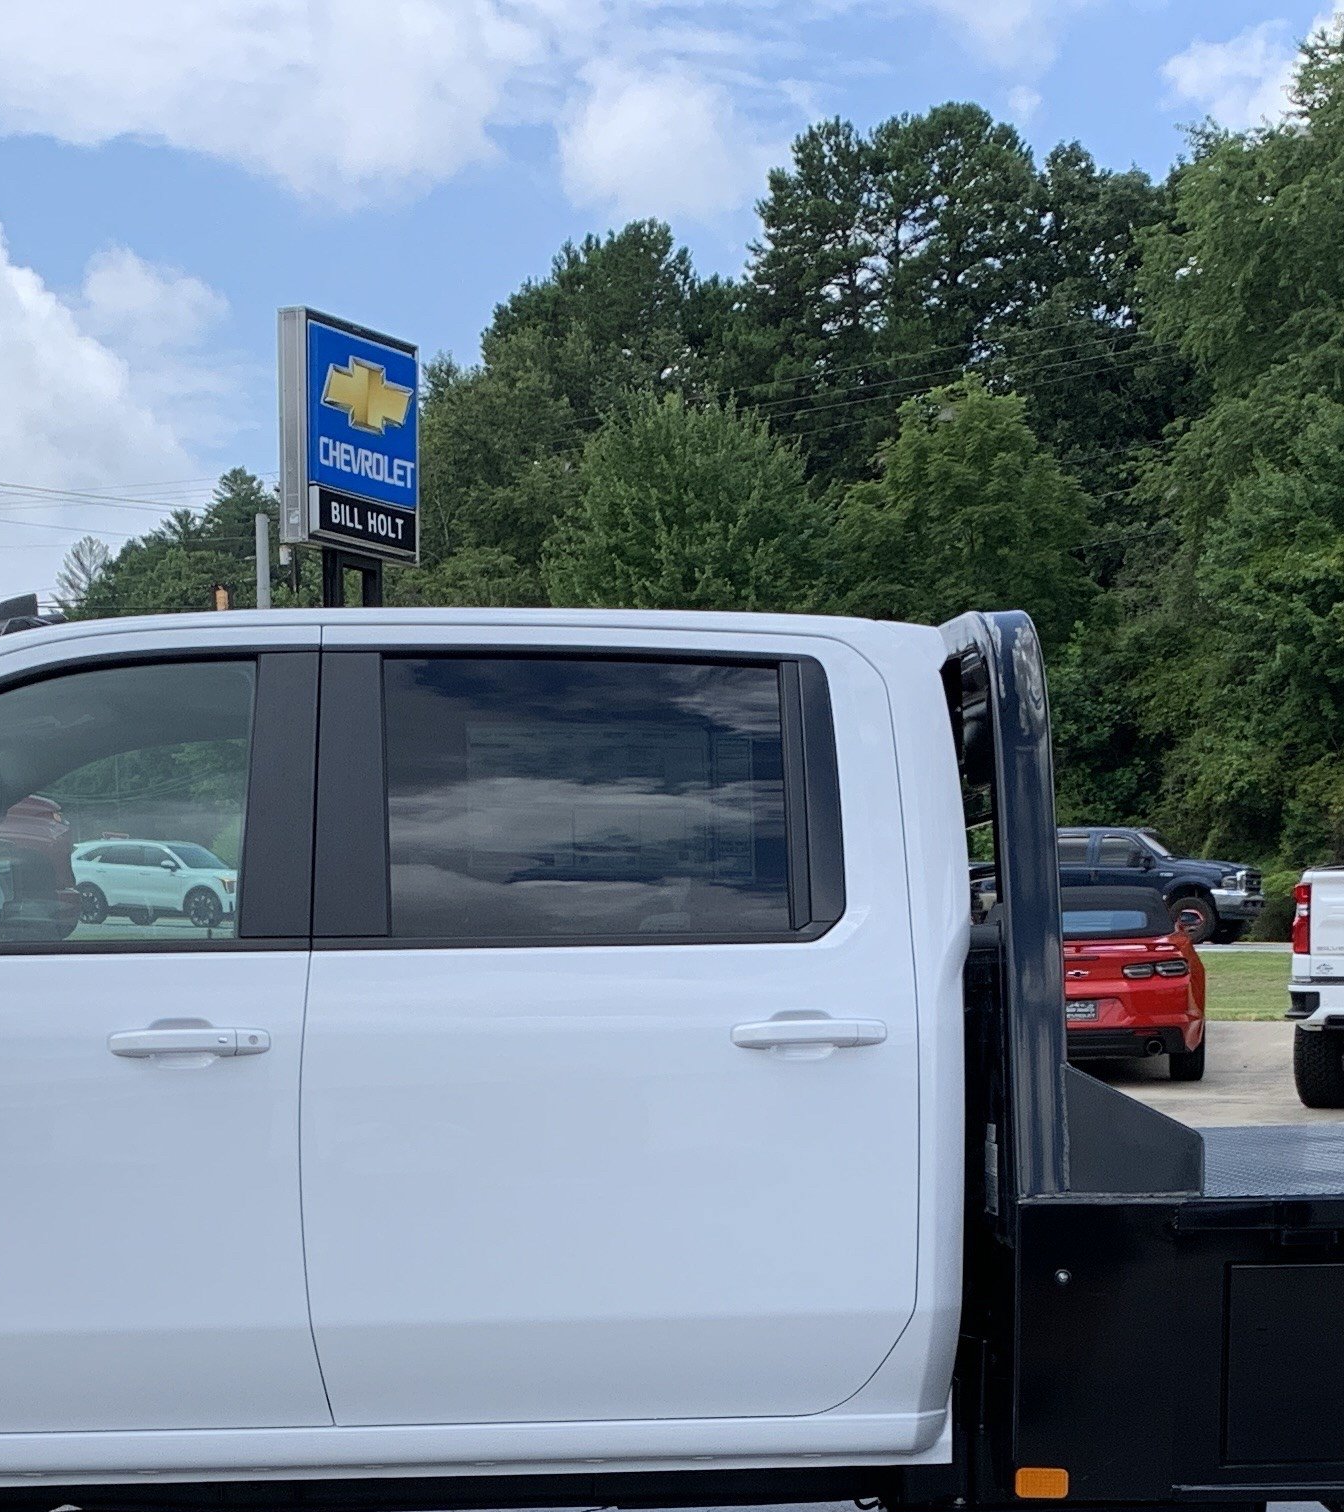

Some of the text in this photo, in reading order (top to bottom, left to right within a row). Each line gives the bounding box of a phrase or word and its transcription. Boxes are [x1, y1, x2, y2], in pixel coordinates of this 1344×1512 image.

[319, 435, 415, 489] CHEVROLET
[330, 501, 404, 540] BILL HOLT
